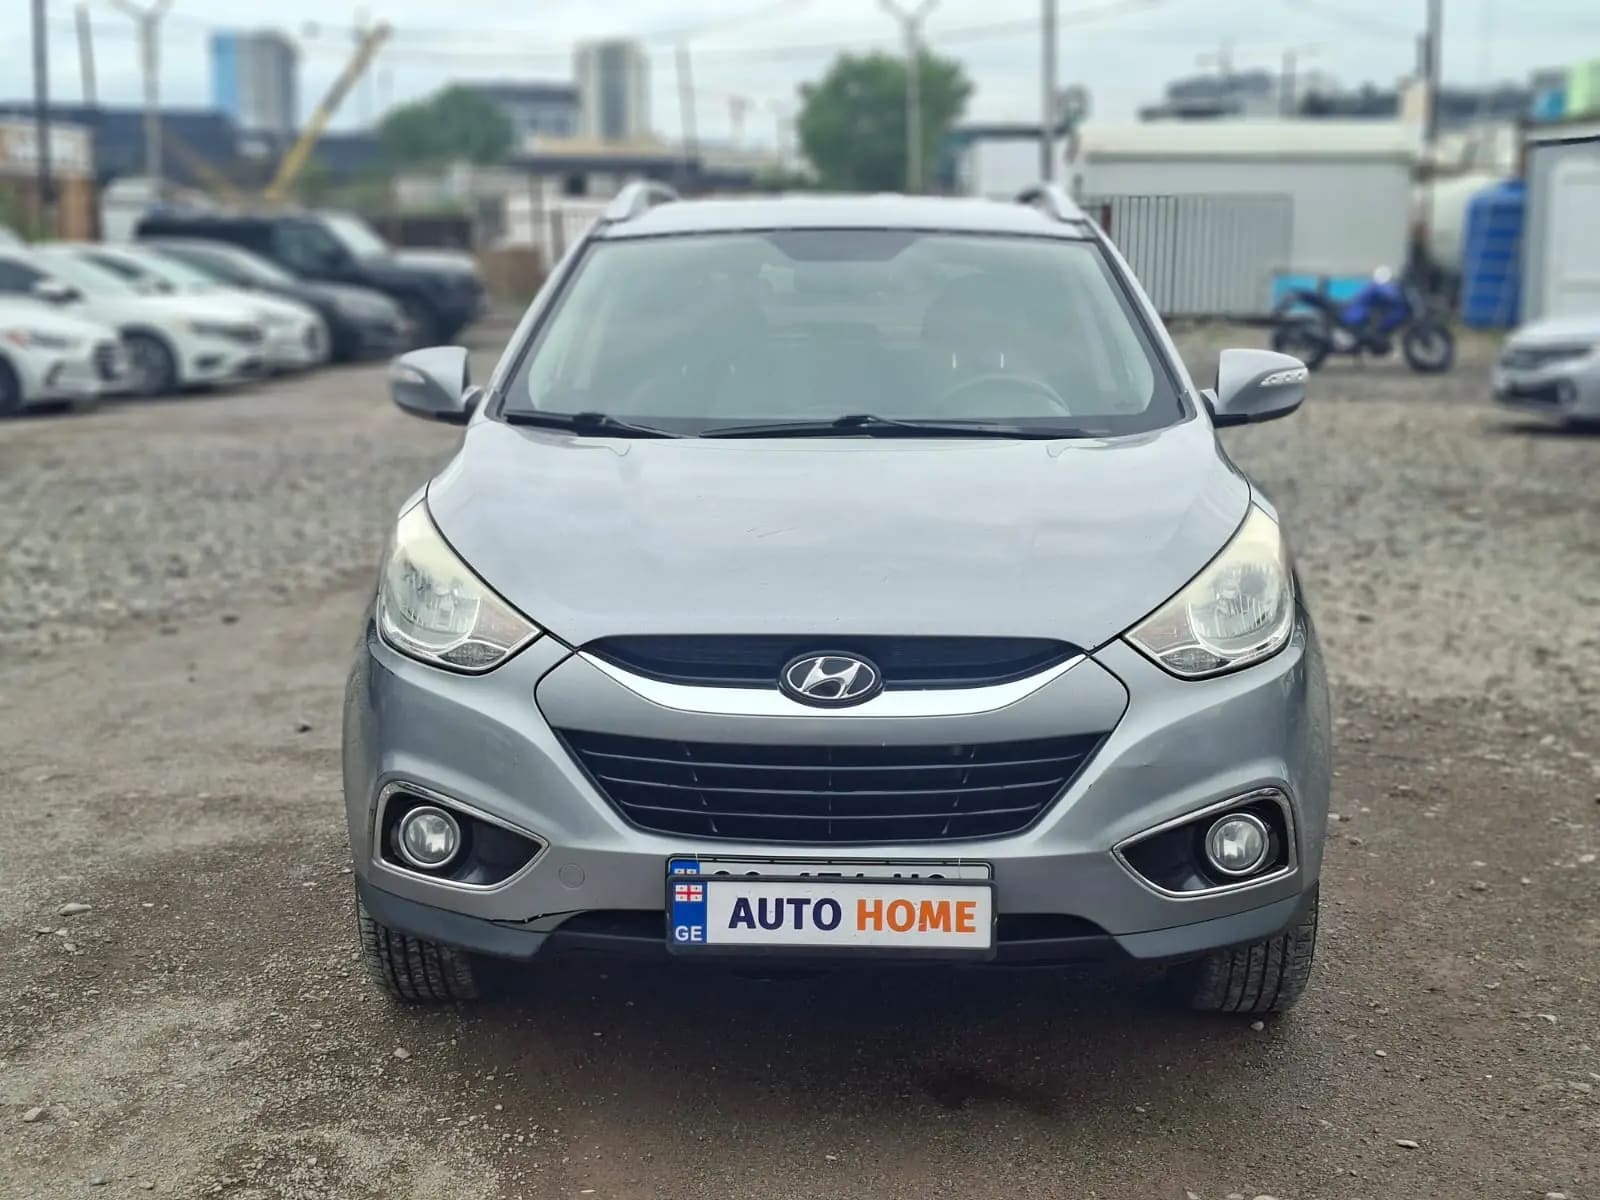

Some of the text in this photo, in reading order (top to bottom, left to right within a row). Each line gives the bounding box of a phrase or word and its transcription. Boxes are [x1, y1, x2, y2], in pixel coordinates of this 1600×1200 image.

[727, 897, 977, 933] AUTO HOME
[675, 925, 703, 942] GE
